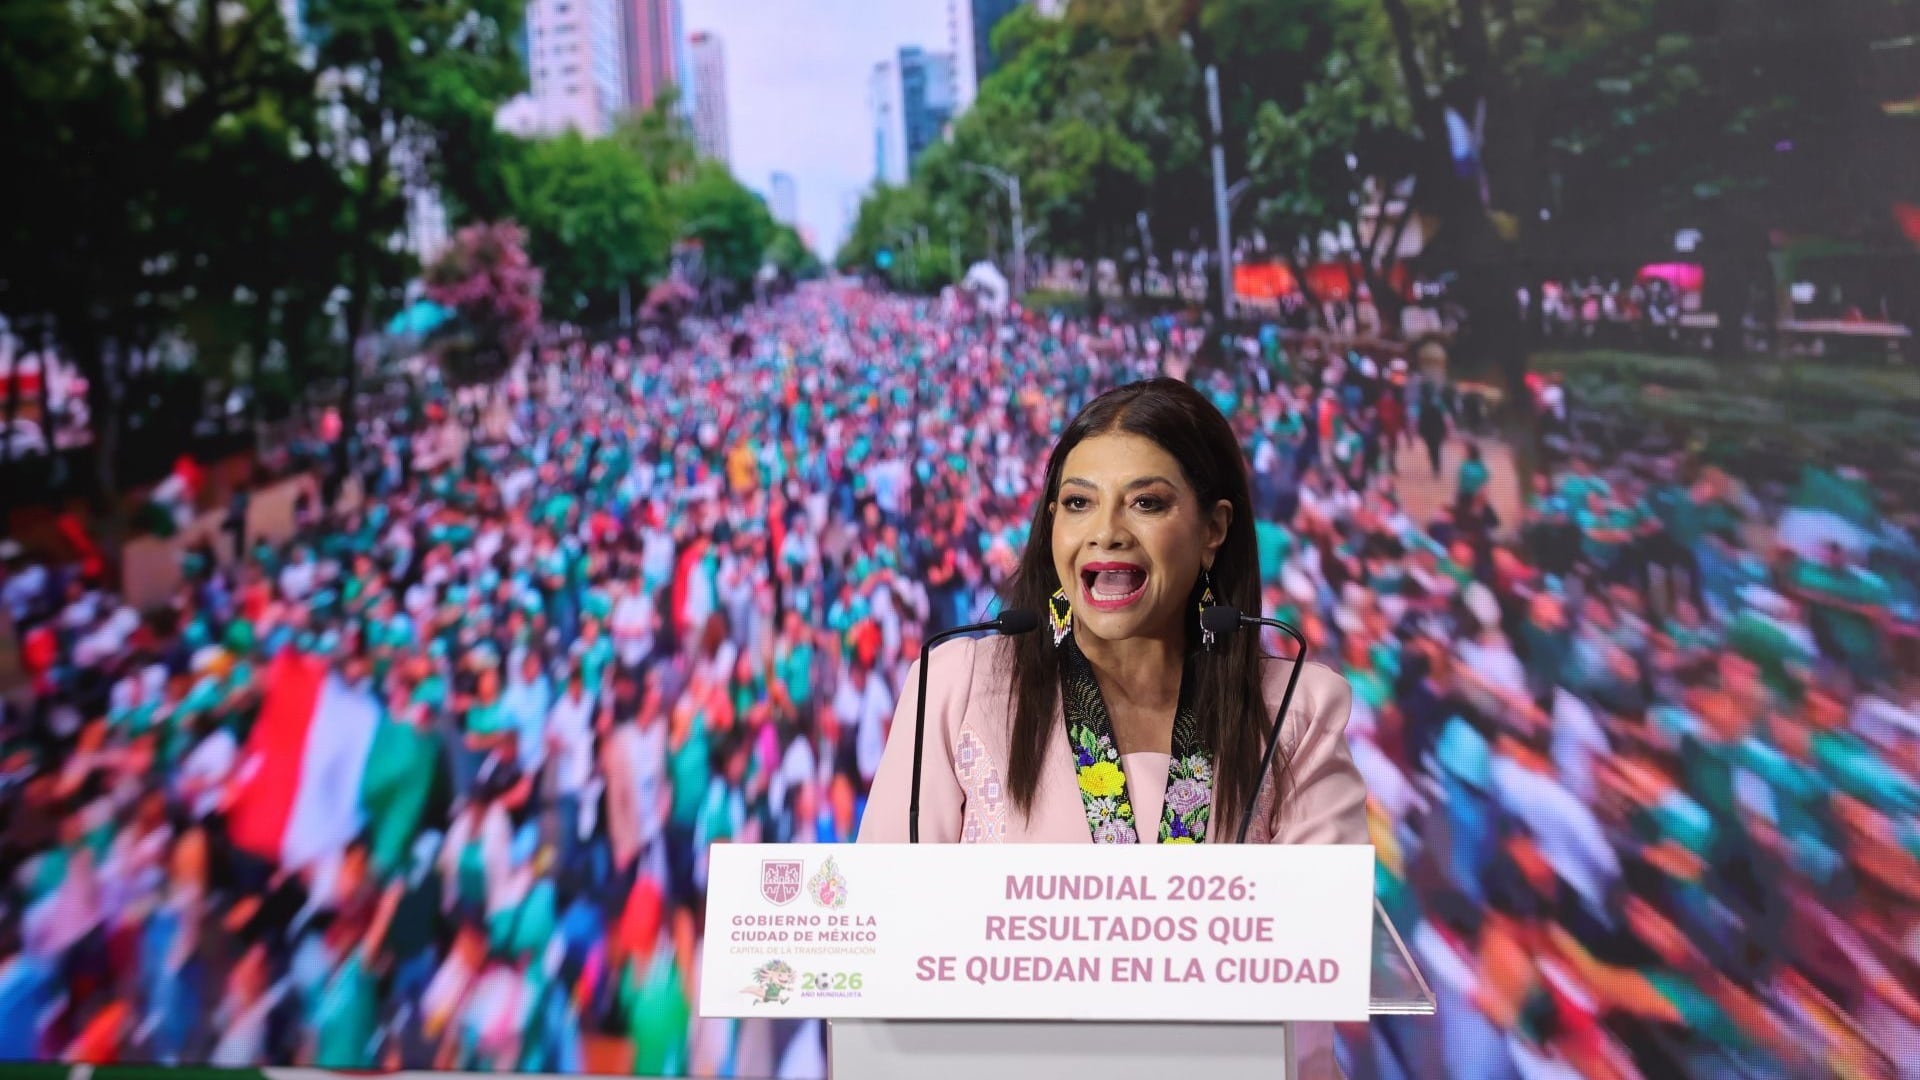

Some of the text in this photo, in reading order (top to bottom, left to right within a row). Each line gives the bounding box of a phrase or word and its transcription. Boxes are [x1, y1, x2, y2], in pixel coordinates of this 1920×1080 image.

[1005, 874, 1256, 902] MUNDIAL 2026:
[731, 915, 877, 927] GOBIERNO DE LA
[985, 915, 1275, 946] RESULTADOS QUE
[730, 928, 877, 942] CIUDAD DE MÉXICO
[729, 944, 876, 955] CAPITAL DE LA TRANSFORMACIÓN
[915, 955, 1340, 985] SE QUEDAN EN LA CIUDAD
